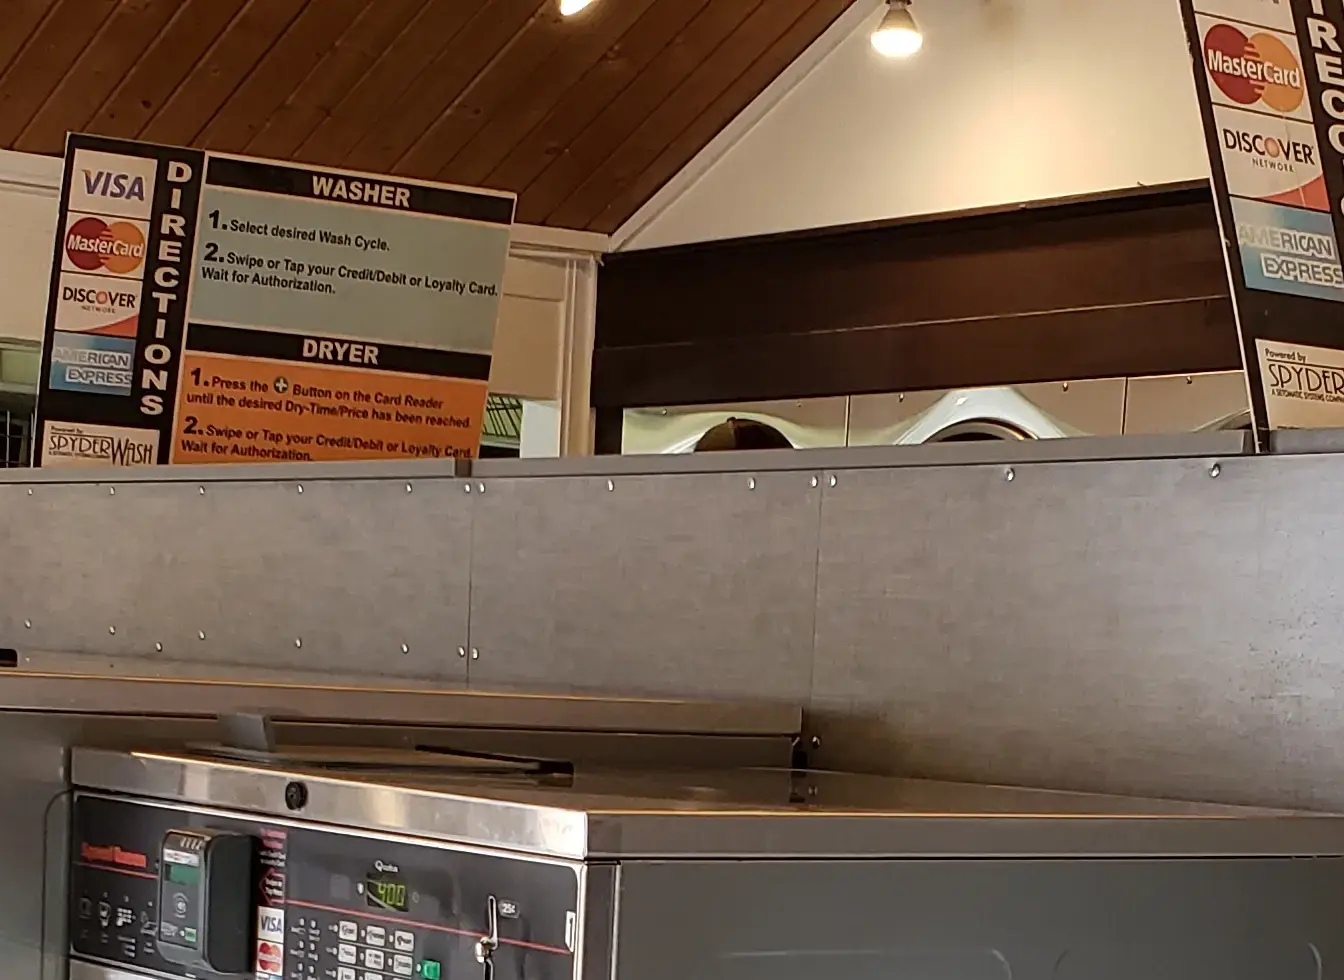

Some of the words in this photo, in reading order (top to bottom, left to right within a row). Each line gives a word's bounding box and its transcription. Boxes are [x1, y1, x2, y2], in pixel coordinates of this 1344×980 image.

[1207, 49, 1301, 88] MasterCard
[1222, 128, 1315, 166] DISCOVER
[1252, 158, 1294, 173] NETWORK
[81, 168, 145, 201] VISA
[313, 175, 410, 208] WASHER
[67, 234, 144, 258] MasterCard
[208, 210, 228, 230] 1.
[230, 219, 268, 236] Select
[271, 224, 316, 242] desired
[319, 230, 351, 246] Wash
[355, 235, 390, 252] Cycle.
[1239, 225, 1332, 258] AMERICAN
[201, 267, 229, 281] Wait
[232, 270, 249, 284] for
[252, 273, 336, 294] Authorization.
[204, 243, 224, 262] 2.
[227, 252, 264, 269] Swipe
[267, 259, 280, 269] or
[284, 259, 304, 275] Tap
[307, 265, 335, 277] your
[338, 266, 407, 285] Credit/Debit
[410, 276, 422, 287] or
[425, 275, 465, 296] Loyalty
[468, 282, 498, 296] Card.
[1264, 256, 1343, 284] EXPRESS
[62, 286, 136, 308] DISCOVER
[140, 161, 193, 415] DIRECTIONS
[53, 348, 129, 367] AMERICAN
[303, 339, 379, 365] DRYER
[1265, 348, 1295, 360] Powered
[1297, 352, 1306, 363] by
[68, 369, 133, 385] EXPRESS
[190, 368, 210, 387] 1.
[212, 376, 246, 391] Press
[250, 378, 269, 392] the
[293, 384, 332, 399] Button
[335, 391, 350, 401] on
[353, 390, 372, 403] the
[374, 392, 402, 406] Card
[404, 396, 444, 410] Reader
[186, 392, 214, 405] until
[216, 394, 235, 407] the
[238, 396, 282, 411] desired
[285, 400, 368, 419] Dry-Time/Price
[371, 408, 392, 422] has
[395, 410, 422, 424] been
[425, 414, 471, 428] reached.
[181, 439, 208, 452] Wait
[211, 442, 228, 454] for
[231, 444, 313, 462] Authorization.
[183, 416, 203, 435] 2.
[206, 425, 242, 439] Swipe
[246, 430, 259, 439] or
[262, 429, 283, 443] Tap
[286, 435, 313, 446] your
[316, 434, 383, 451] Credit/Debit
[386, 441, 399, 452] or
[401, 441, 441, 458] Loyalty
[444, 446, 473, 459] Card.
[260, 915, 282, 934] VISA
